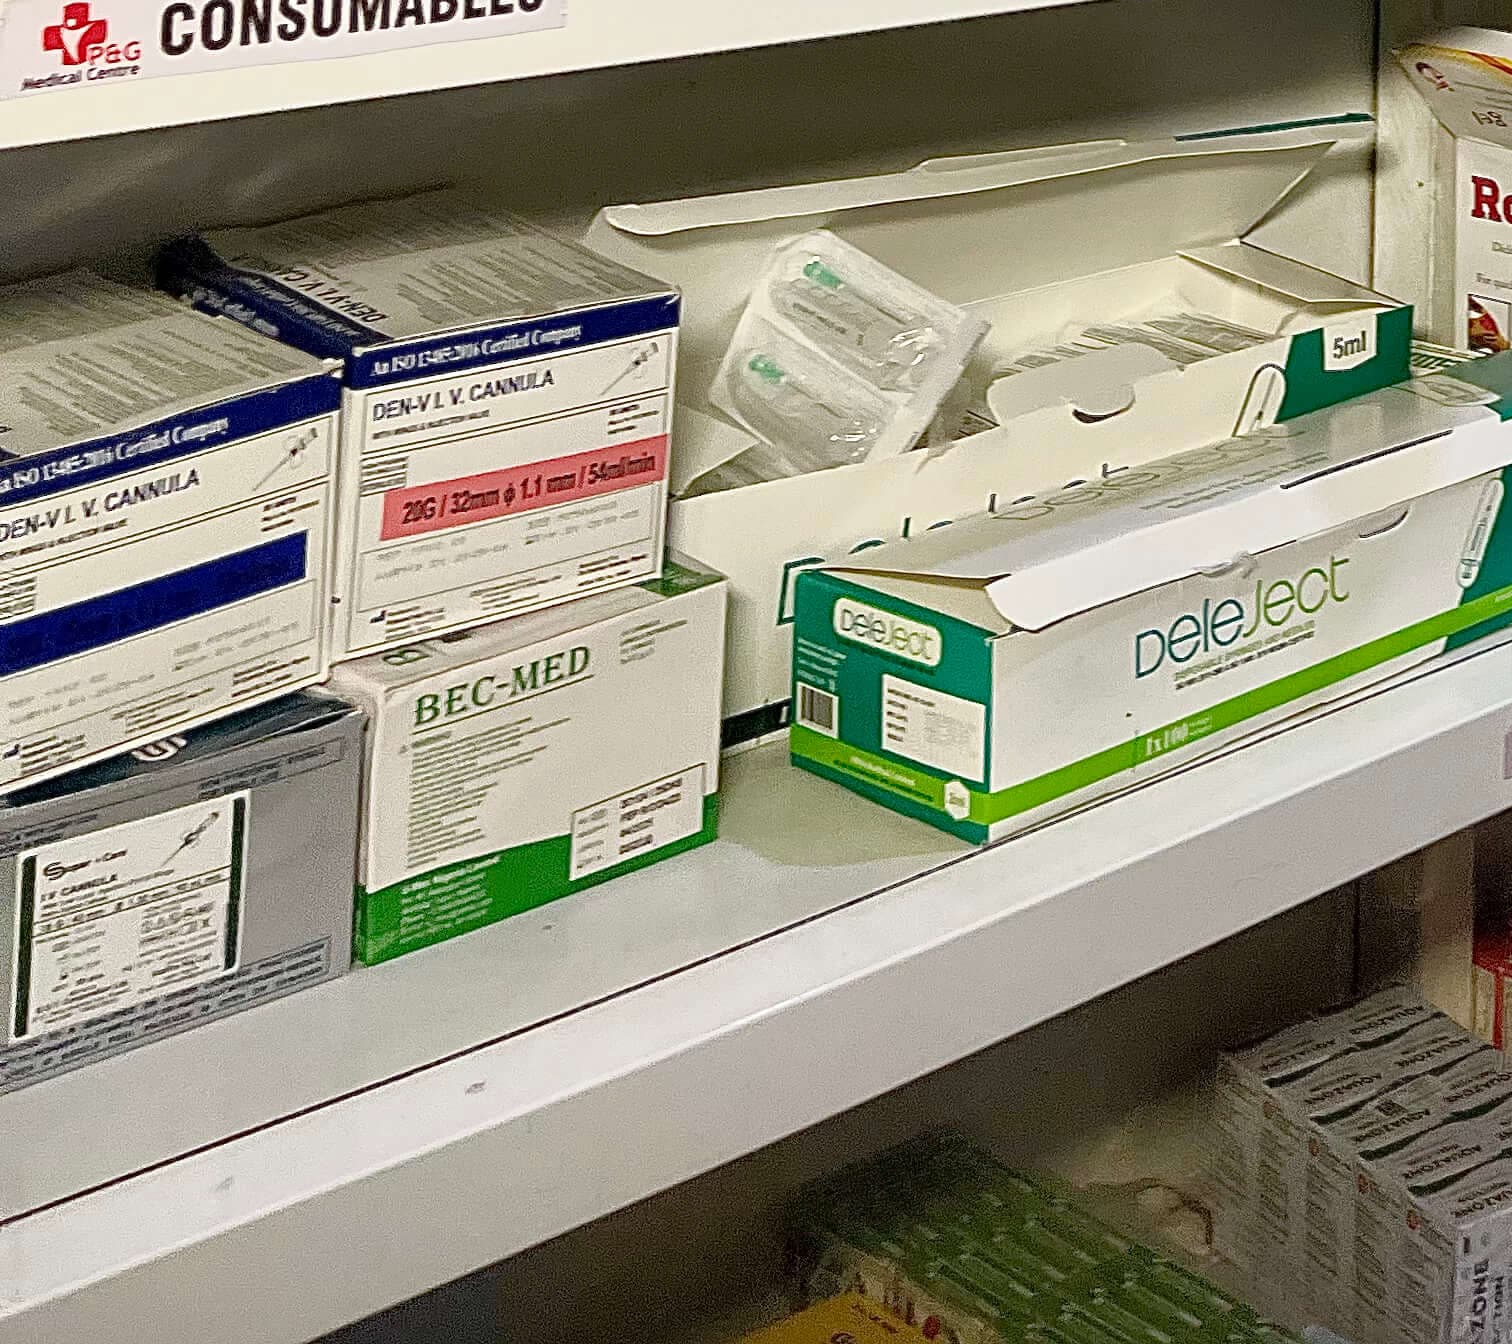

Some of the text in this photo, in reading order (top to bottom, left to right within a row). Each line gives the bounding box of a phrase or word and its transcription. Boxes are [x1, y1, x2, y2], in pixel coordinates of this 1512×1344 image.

[20, 61, 141, 91] Medical Centre
[1332, 330, 1368, 361] 5ml
[373, 391, 432, 422] DEN-V
[469, 368, 556, 402] CANNULA
[103, 467, 201, 513] CANNULA
[519, 475, 542, 500] 1.1
[413, 646, 591, 727] BEC-MED
